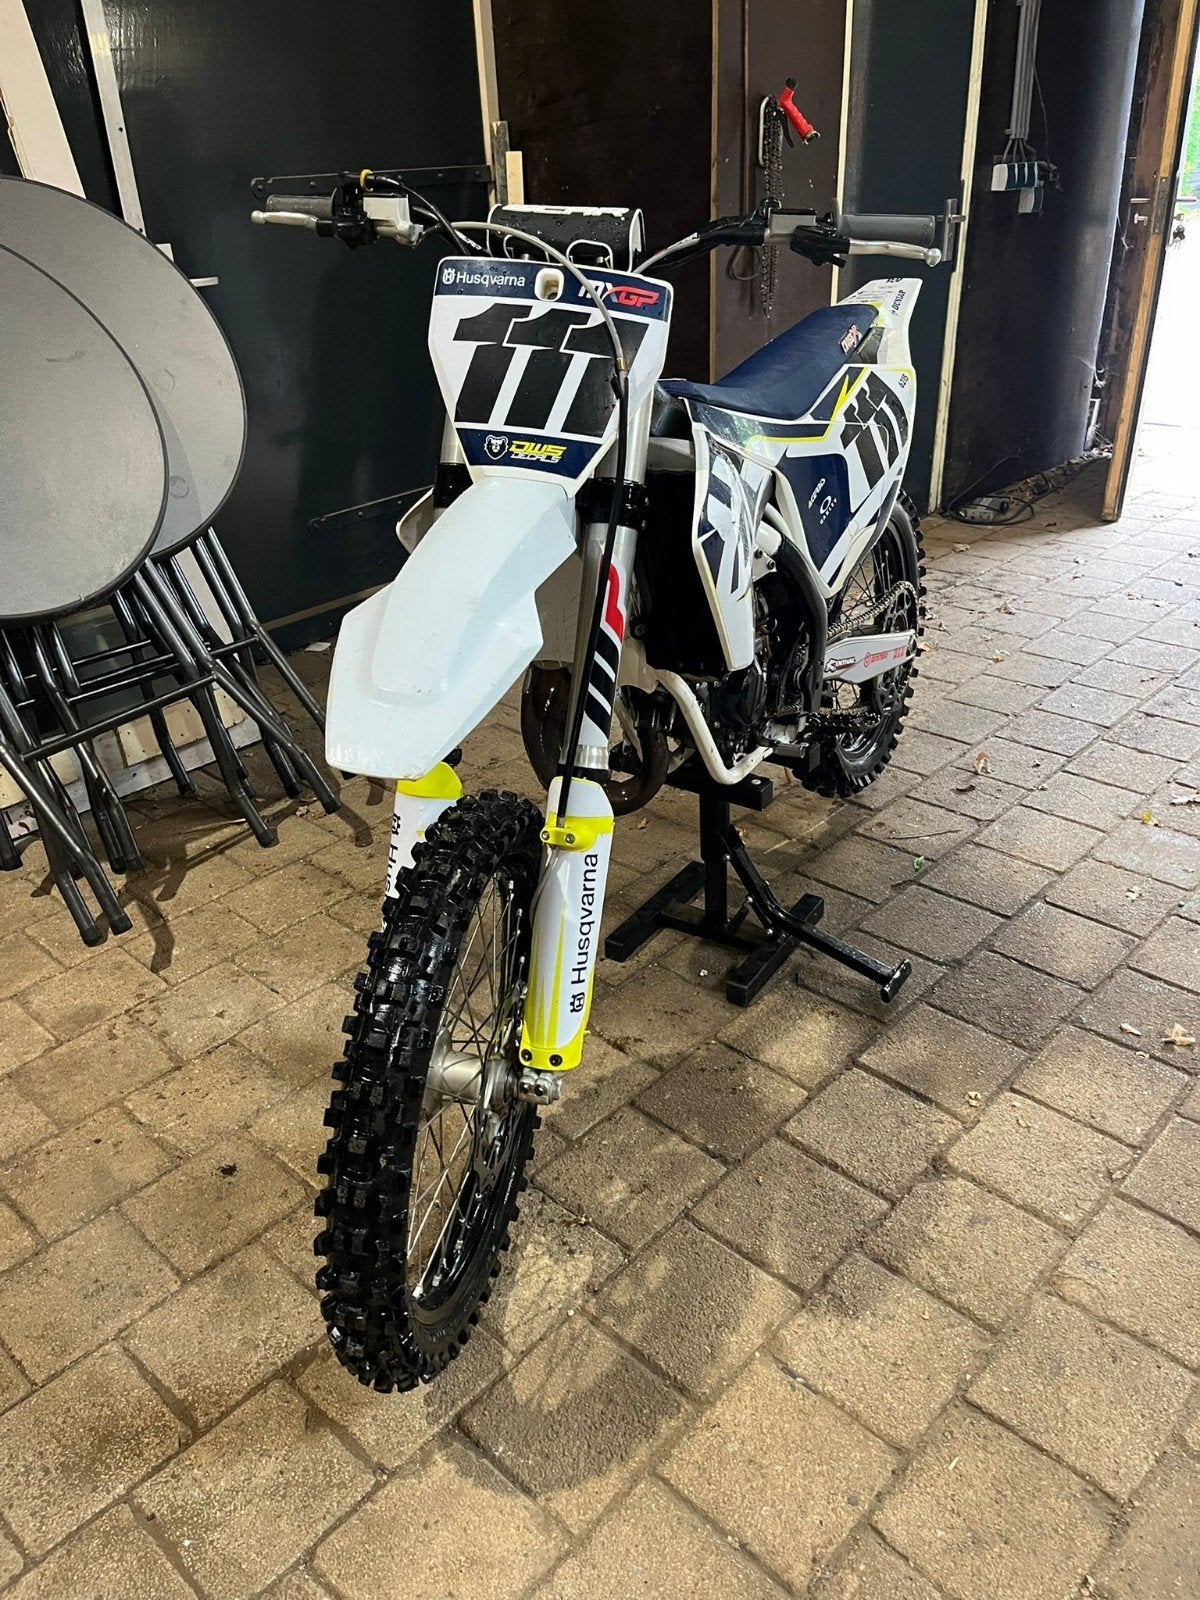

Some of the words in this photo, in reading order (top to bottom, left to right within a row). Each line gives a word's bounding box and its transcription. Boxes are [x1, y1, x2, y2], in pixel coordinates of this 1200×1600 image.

[456, 270, 526, 288] Husqvarna
[453, 302, 650, 439] 111
[571, 853, 599, 986] Husqvarna
